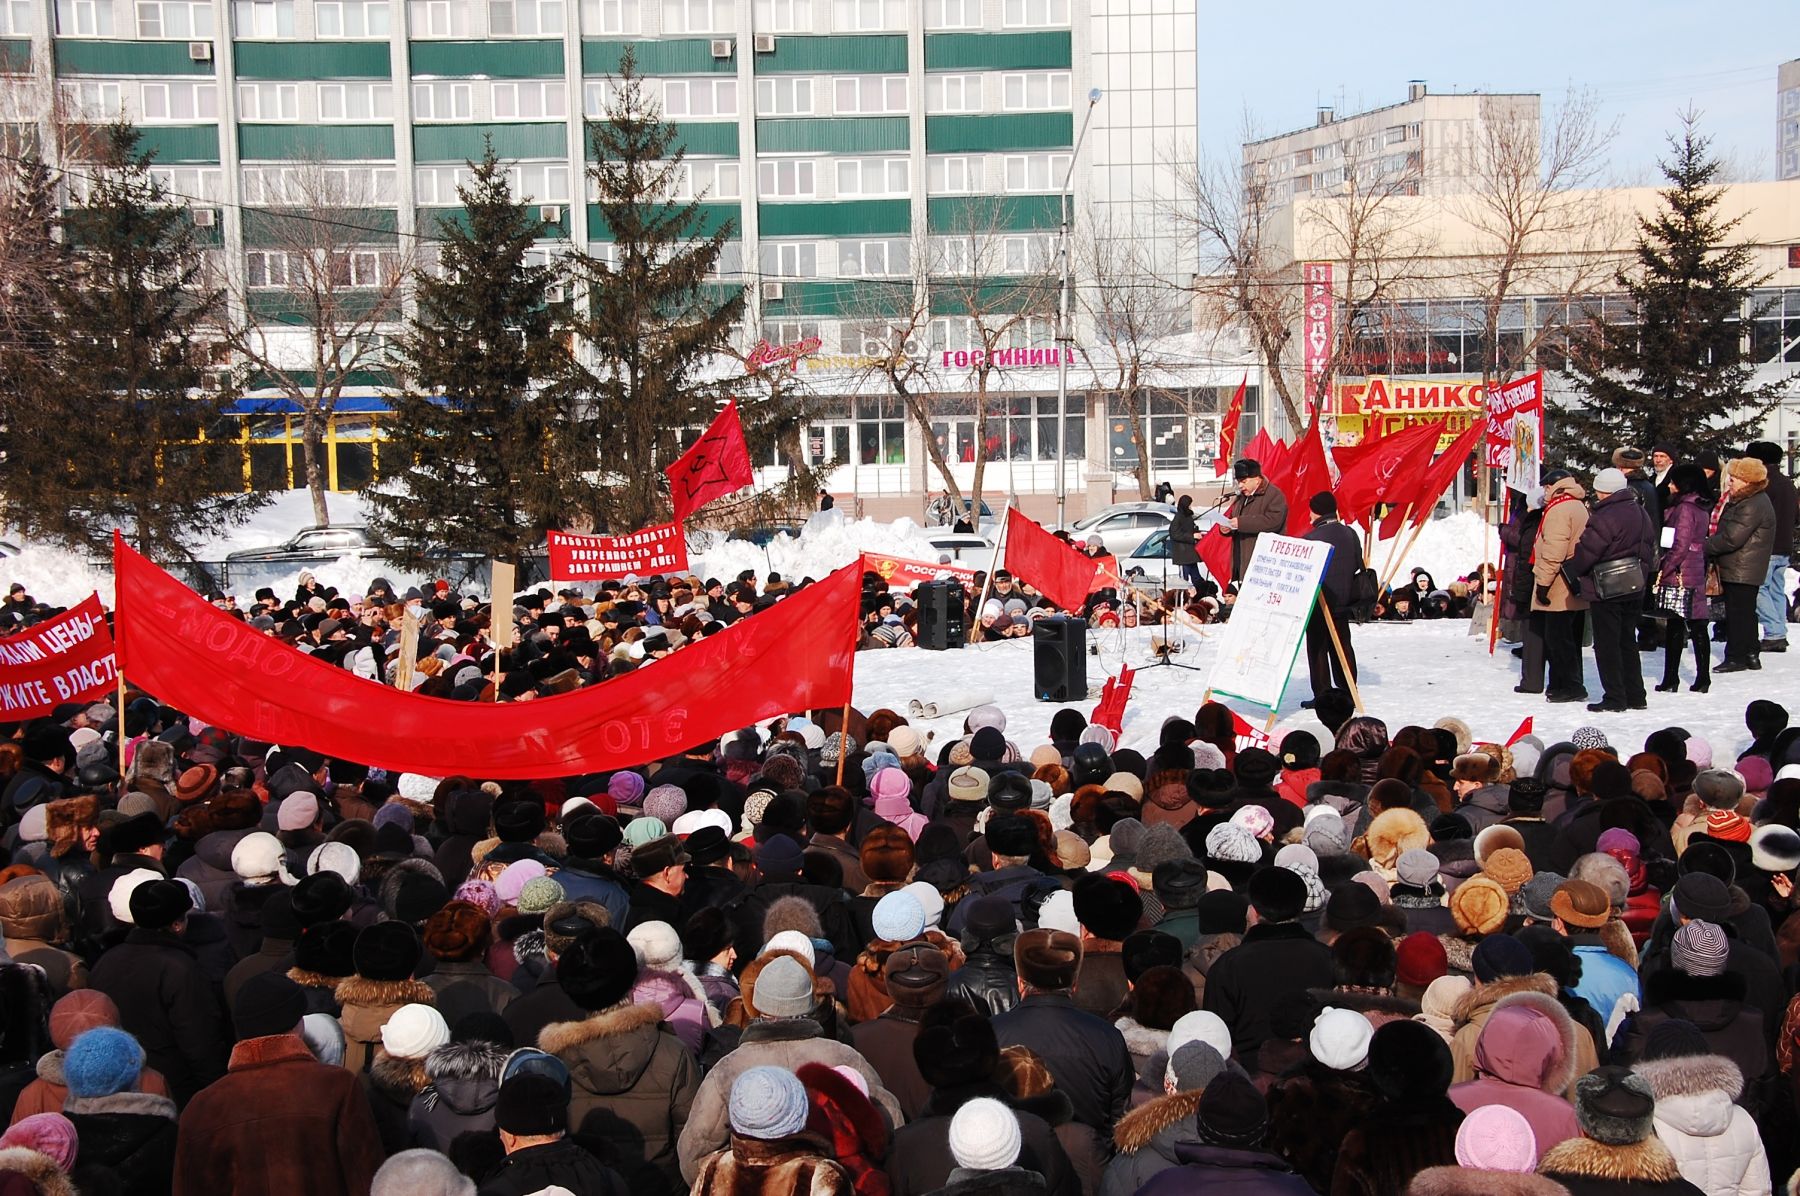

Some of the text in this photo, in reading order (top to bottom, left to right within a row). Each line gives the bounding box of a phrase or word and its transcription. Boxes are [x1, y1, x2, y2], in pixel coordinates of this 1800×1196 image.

[554, 526, 677, 548] РАБОТУ! ЗАРПЛАТУ!
[571, 544, 665, 560] УВЕРЕННОСТЬ В
[1270, 540, 1313, 559] ТРЕБУЕМ!
[568, 554, 676, 574] ЗАВТРАШНЕМ ДНЕ!
[1266, 592, 1282, 606] 354
[0, 680, 52, 711] ЖИТЕ
